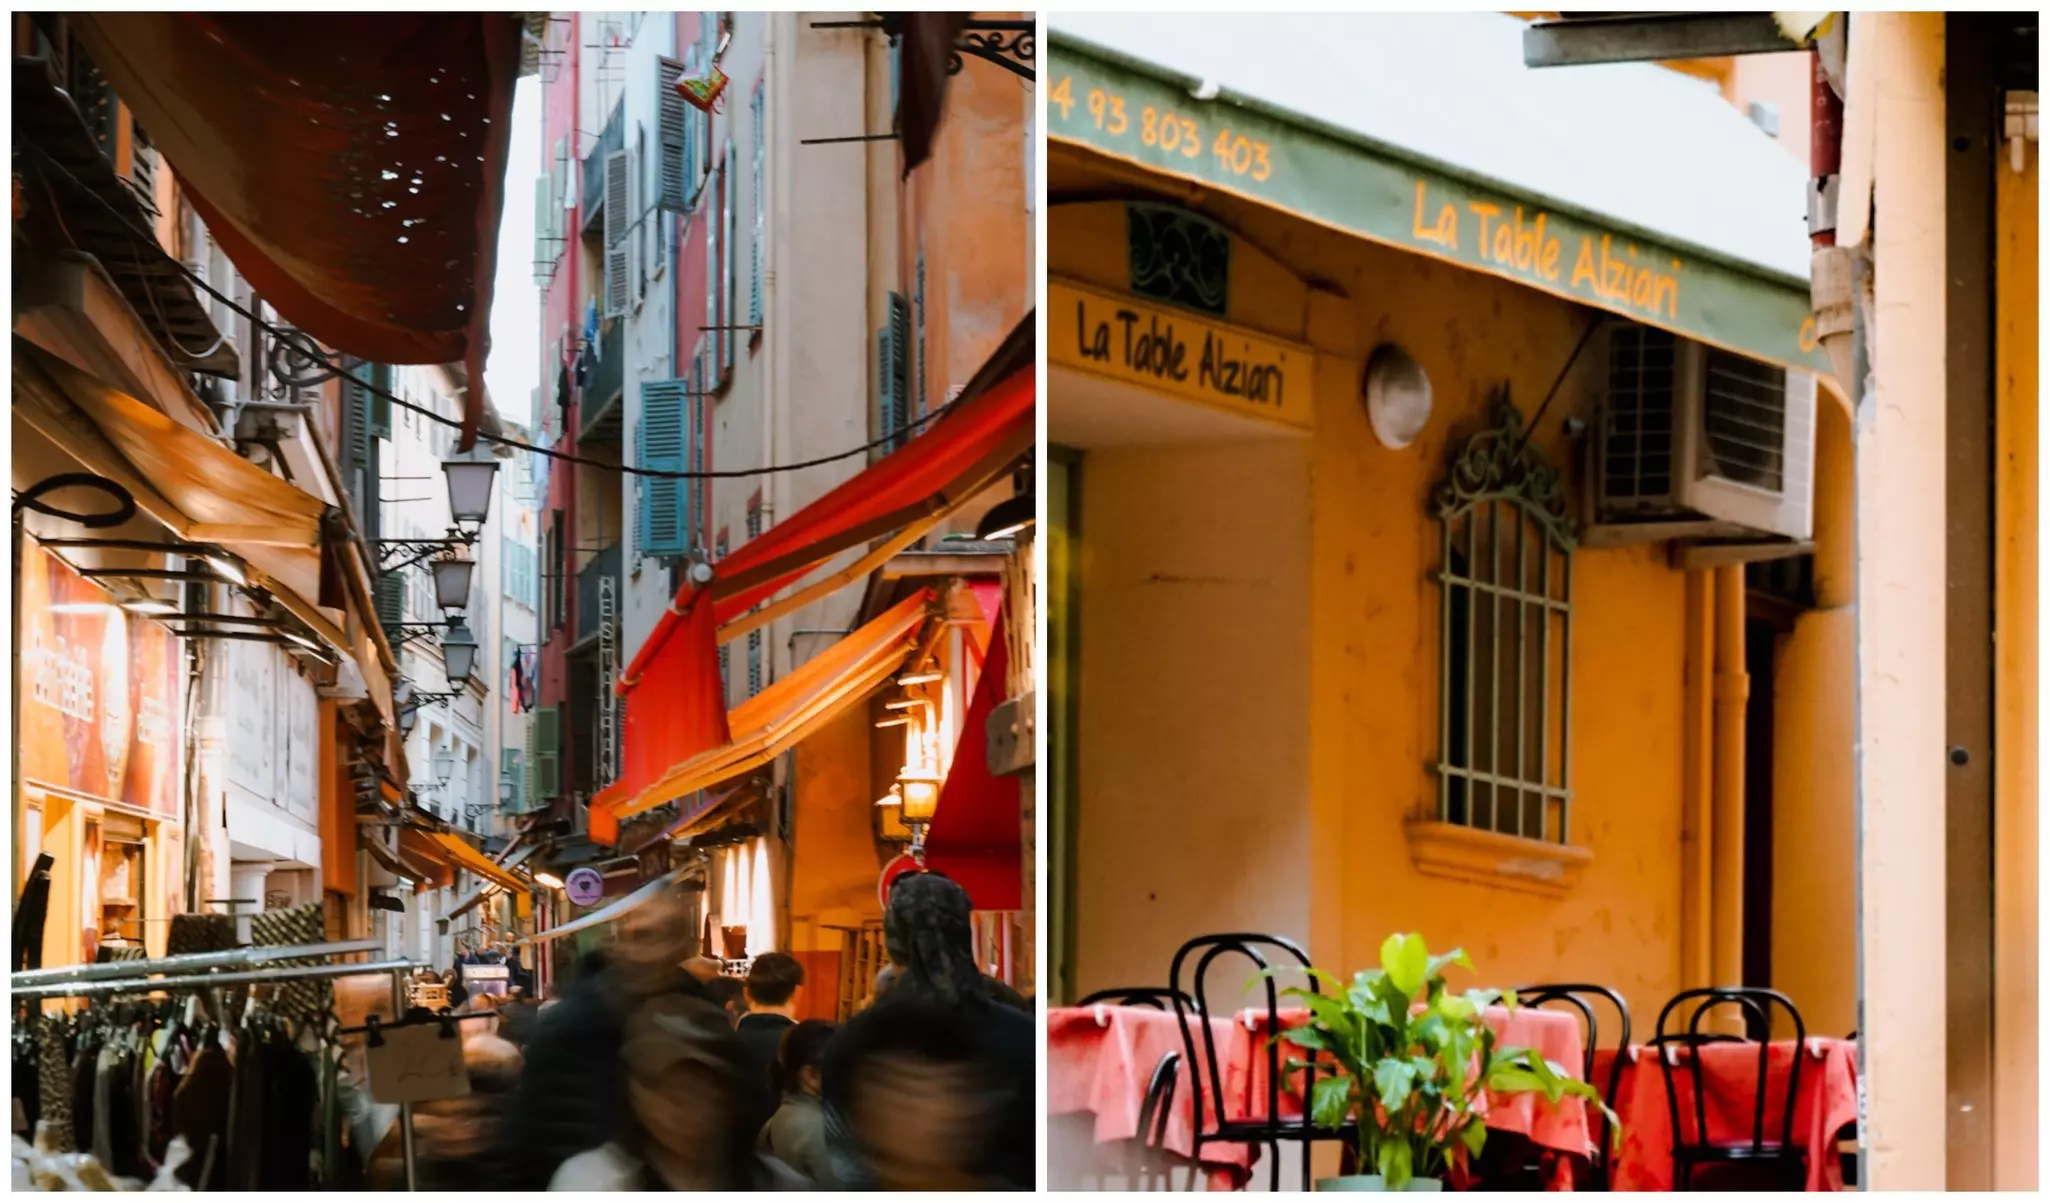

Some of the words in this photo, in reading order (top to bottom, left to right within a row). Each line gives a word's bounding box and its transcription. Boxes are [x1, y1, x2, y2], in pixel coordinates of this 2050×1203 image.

[1047, 75, 1075, 121] 4
[1087, 87, 1128, 136] 93
[1141, 105, 1201, 158] 803
[1212, 127, 1272, 182] 403
[1413, 178, 1457, 250] La
[1469, 202, 1560, 281] Table
[1570, 234, 1682, 321] Alziari
[1077, 300, 1111, 362] La
[1115, 309, 1189, 382] Table
[1198, 328, 1286, 408] Alziari
[599, 574, 616, 788] RESTAURAN
